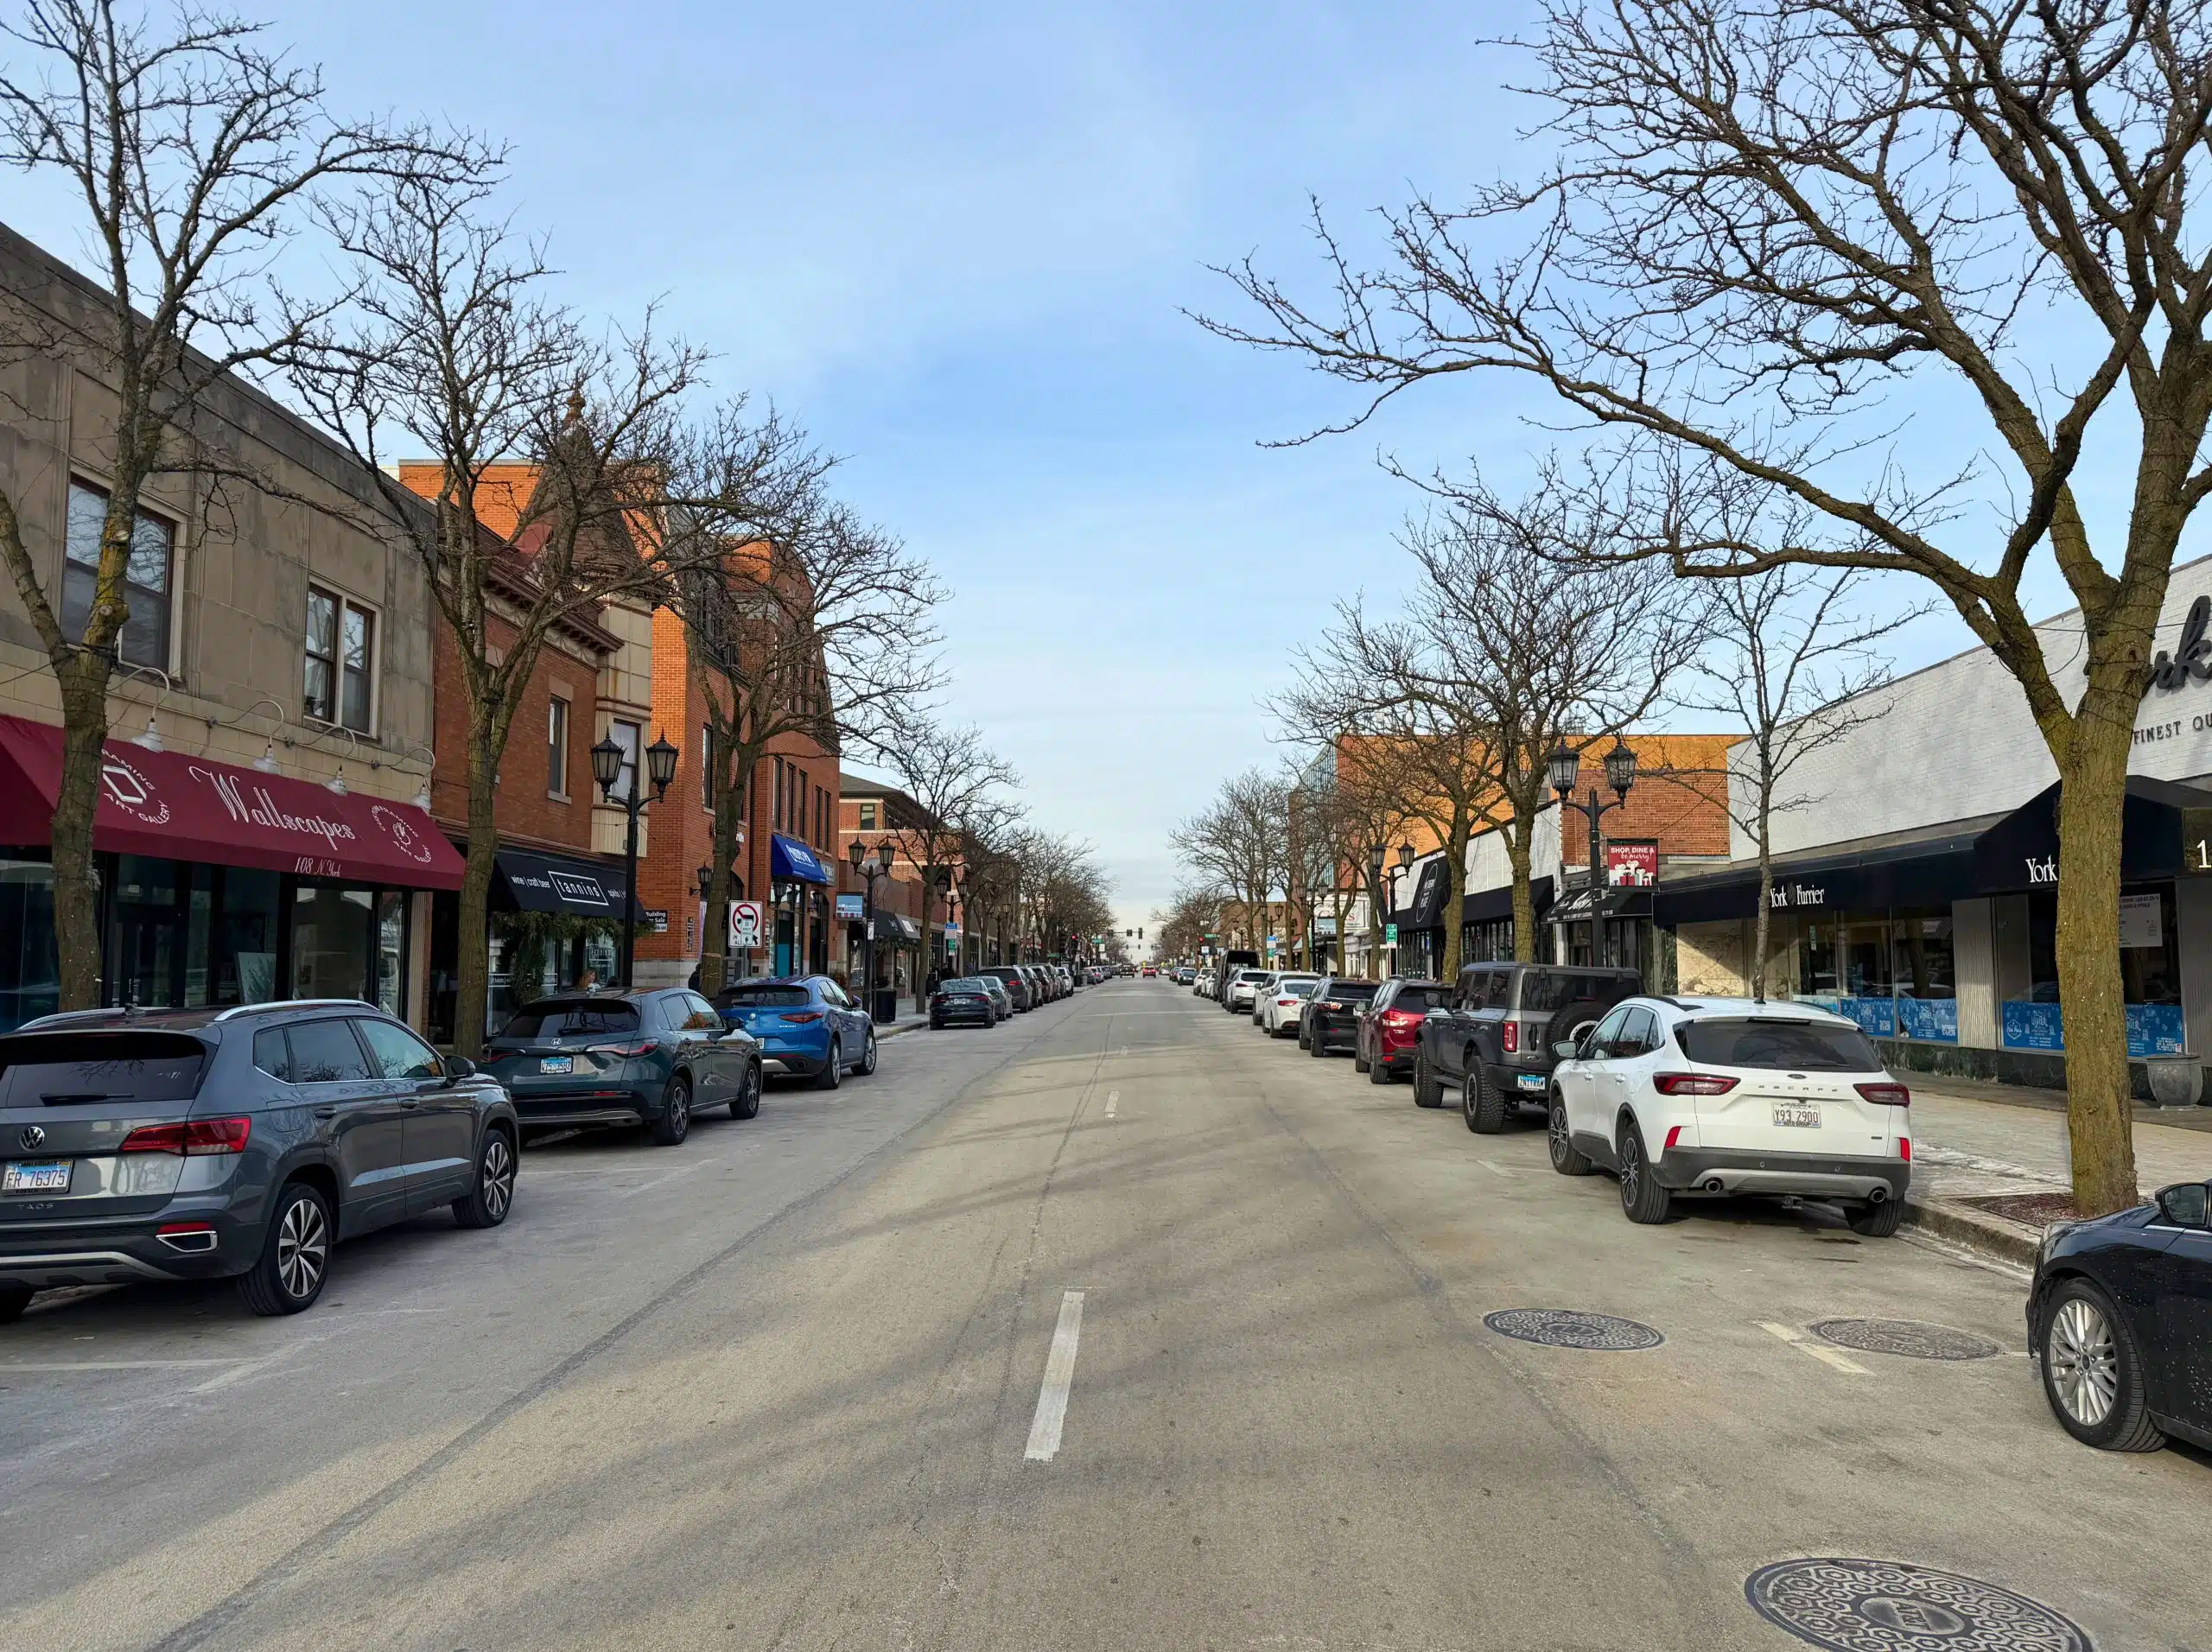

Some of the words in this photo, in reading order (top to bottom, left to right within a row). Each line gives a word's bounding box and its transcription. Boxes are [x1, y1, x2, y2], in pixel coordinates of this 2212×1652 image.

[2133, 721, 2182, 745] FINEST
[101, 748, 156, 790] RAMING
[104, 792, 135, 814] ART
[138, 799, 170, 824] GALLERY
[188, 766, 356, 851] Wallscapes
[295, 856, 314, 874] 108
[2025, 855, 2059, 883] York
[511, 874, 524, 886] wine
[556, 878, 601, 898] tannins
[1770, 885, 1788, 908] York
[1796, 884, 1826, 905] Furrier
[1775, 1109, 1792, 1121] Y93
[1796, 1110, 1819, 1123] 2900
[7, 1172, 22, 1187] FR
[29, 1170, 66, 1186] 76375
[17, 1202, 54, 1210] TAOS
